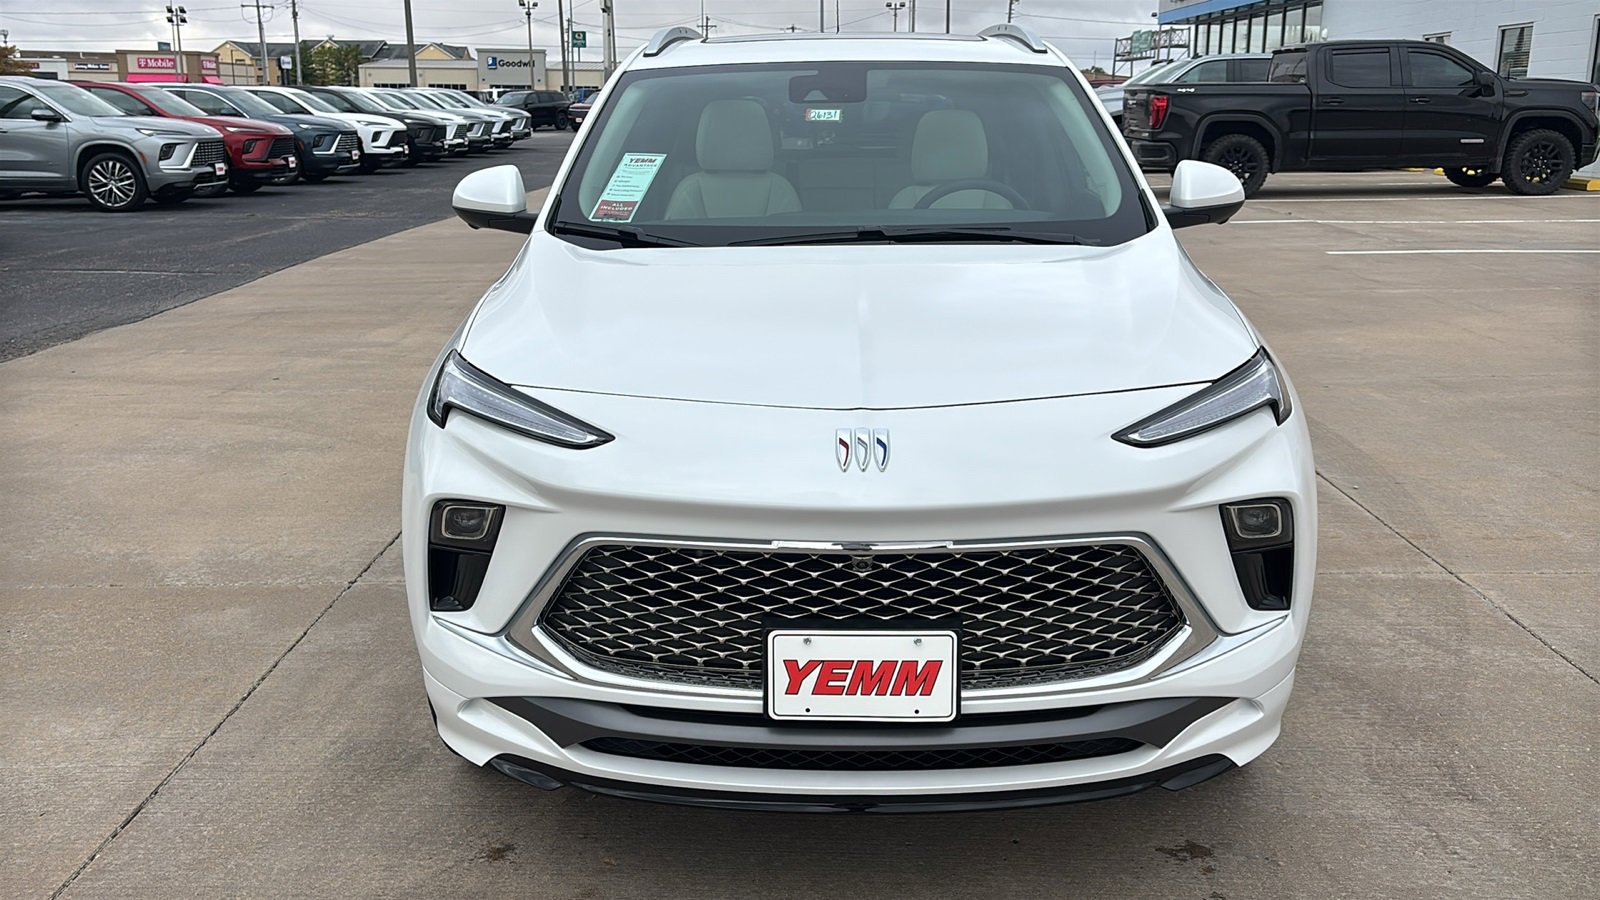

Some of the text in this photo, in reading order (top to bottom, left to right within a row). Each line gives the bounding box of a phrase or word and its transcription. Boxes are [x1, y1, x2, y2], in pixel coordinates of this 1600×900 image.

[147, 59, 174, 67] Mobile
[498, 59, 535, 68] Goodwil
[783, 659, 944, 697] YEMM
